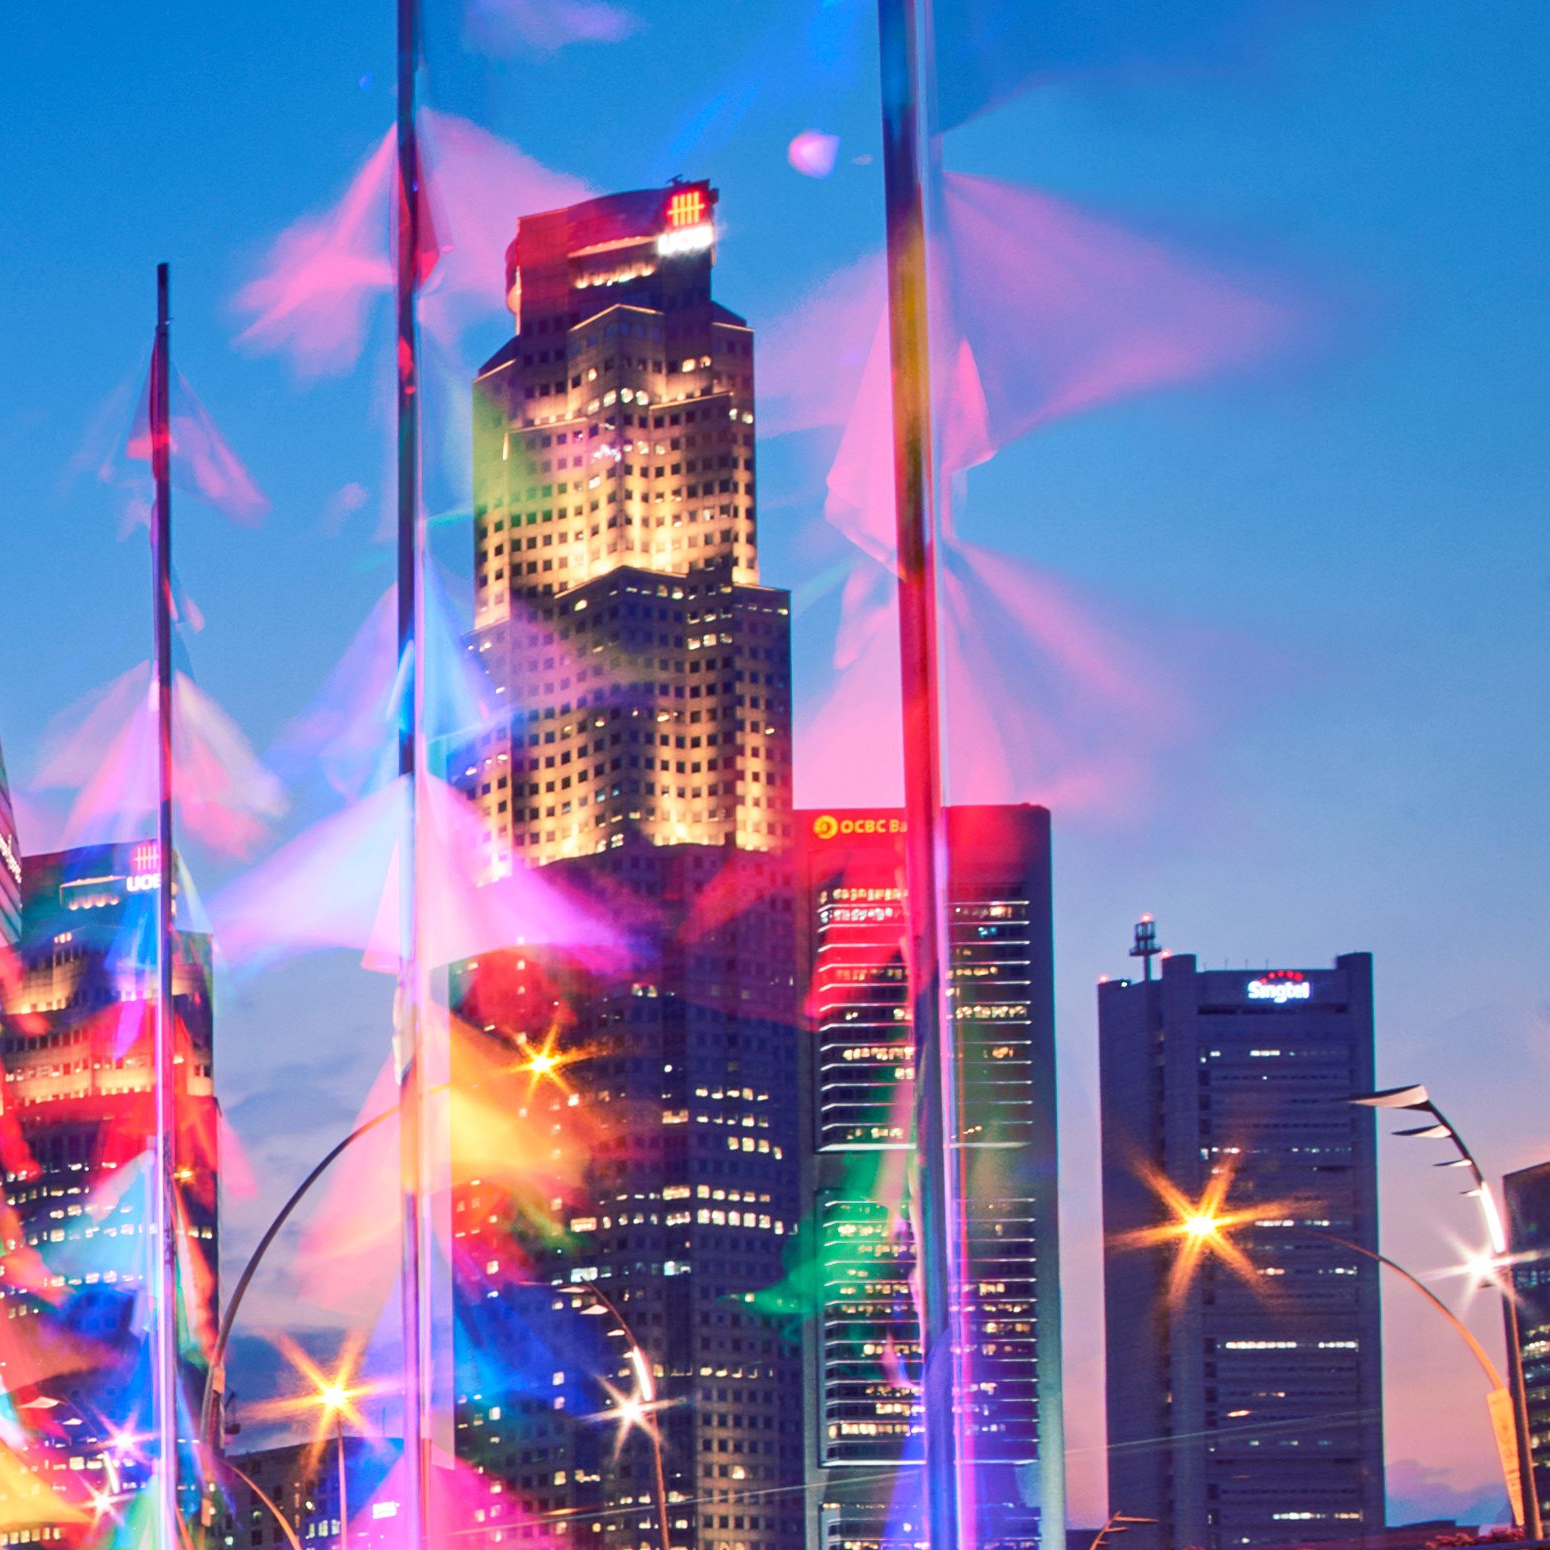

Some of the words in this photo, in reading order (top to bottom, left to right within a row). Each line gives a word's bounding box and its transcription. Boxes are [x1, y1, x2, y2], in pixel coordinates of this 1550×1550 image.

[840, 819, 887, 833] OCBC
[889, 819, 908, 833] Ba
[1247, 980, 1310, 1003] Singtel
